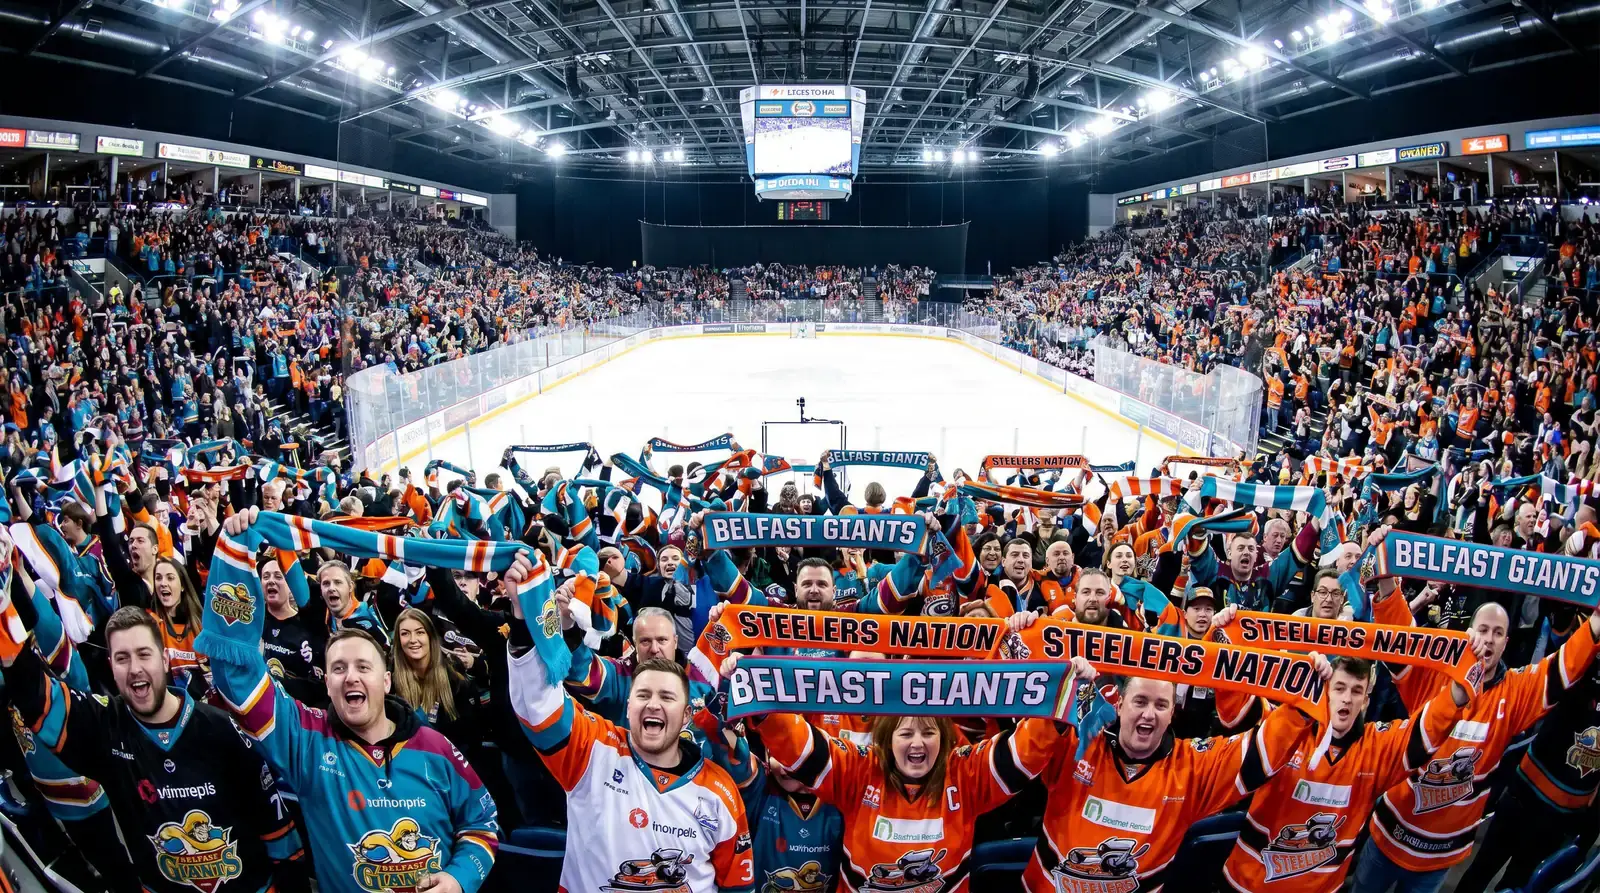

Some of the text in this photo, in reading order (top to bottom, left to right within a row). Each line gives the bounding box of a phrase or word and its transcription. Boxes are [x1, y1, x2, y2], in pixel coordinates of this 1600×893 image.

[827, 451, 928, 466] BELFAST GIANTS
[992, 457, 1081, 466] STEELERS NATION
[712, 516, 916, 544] BELFAST GIANTS
[1395, 539, 1599, 596] BELFAST GIANTS
[737, 611, 998, 651] STEELERS NATION
[1239, 617, 1468, 667] STEELERS NATION
[1042, 625, 1325, 704] STEELERS NATION
[729, 667, 1050, 706] BELFAST GIANTS
[1497, 699, 1505, 719] C
[947, 786, 960, 811] C
[159, 847, 240, 883] GIANTS
[357, 856, 441, 891] GIANS
[382, 862, 424, 872] BELFAST
[741, 859, 752, 881] 3
